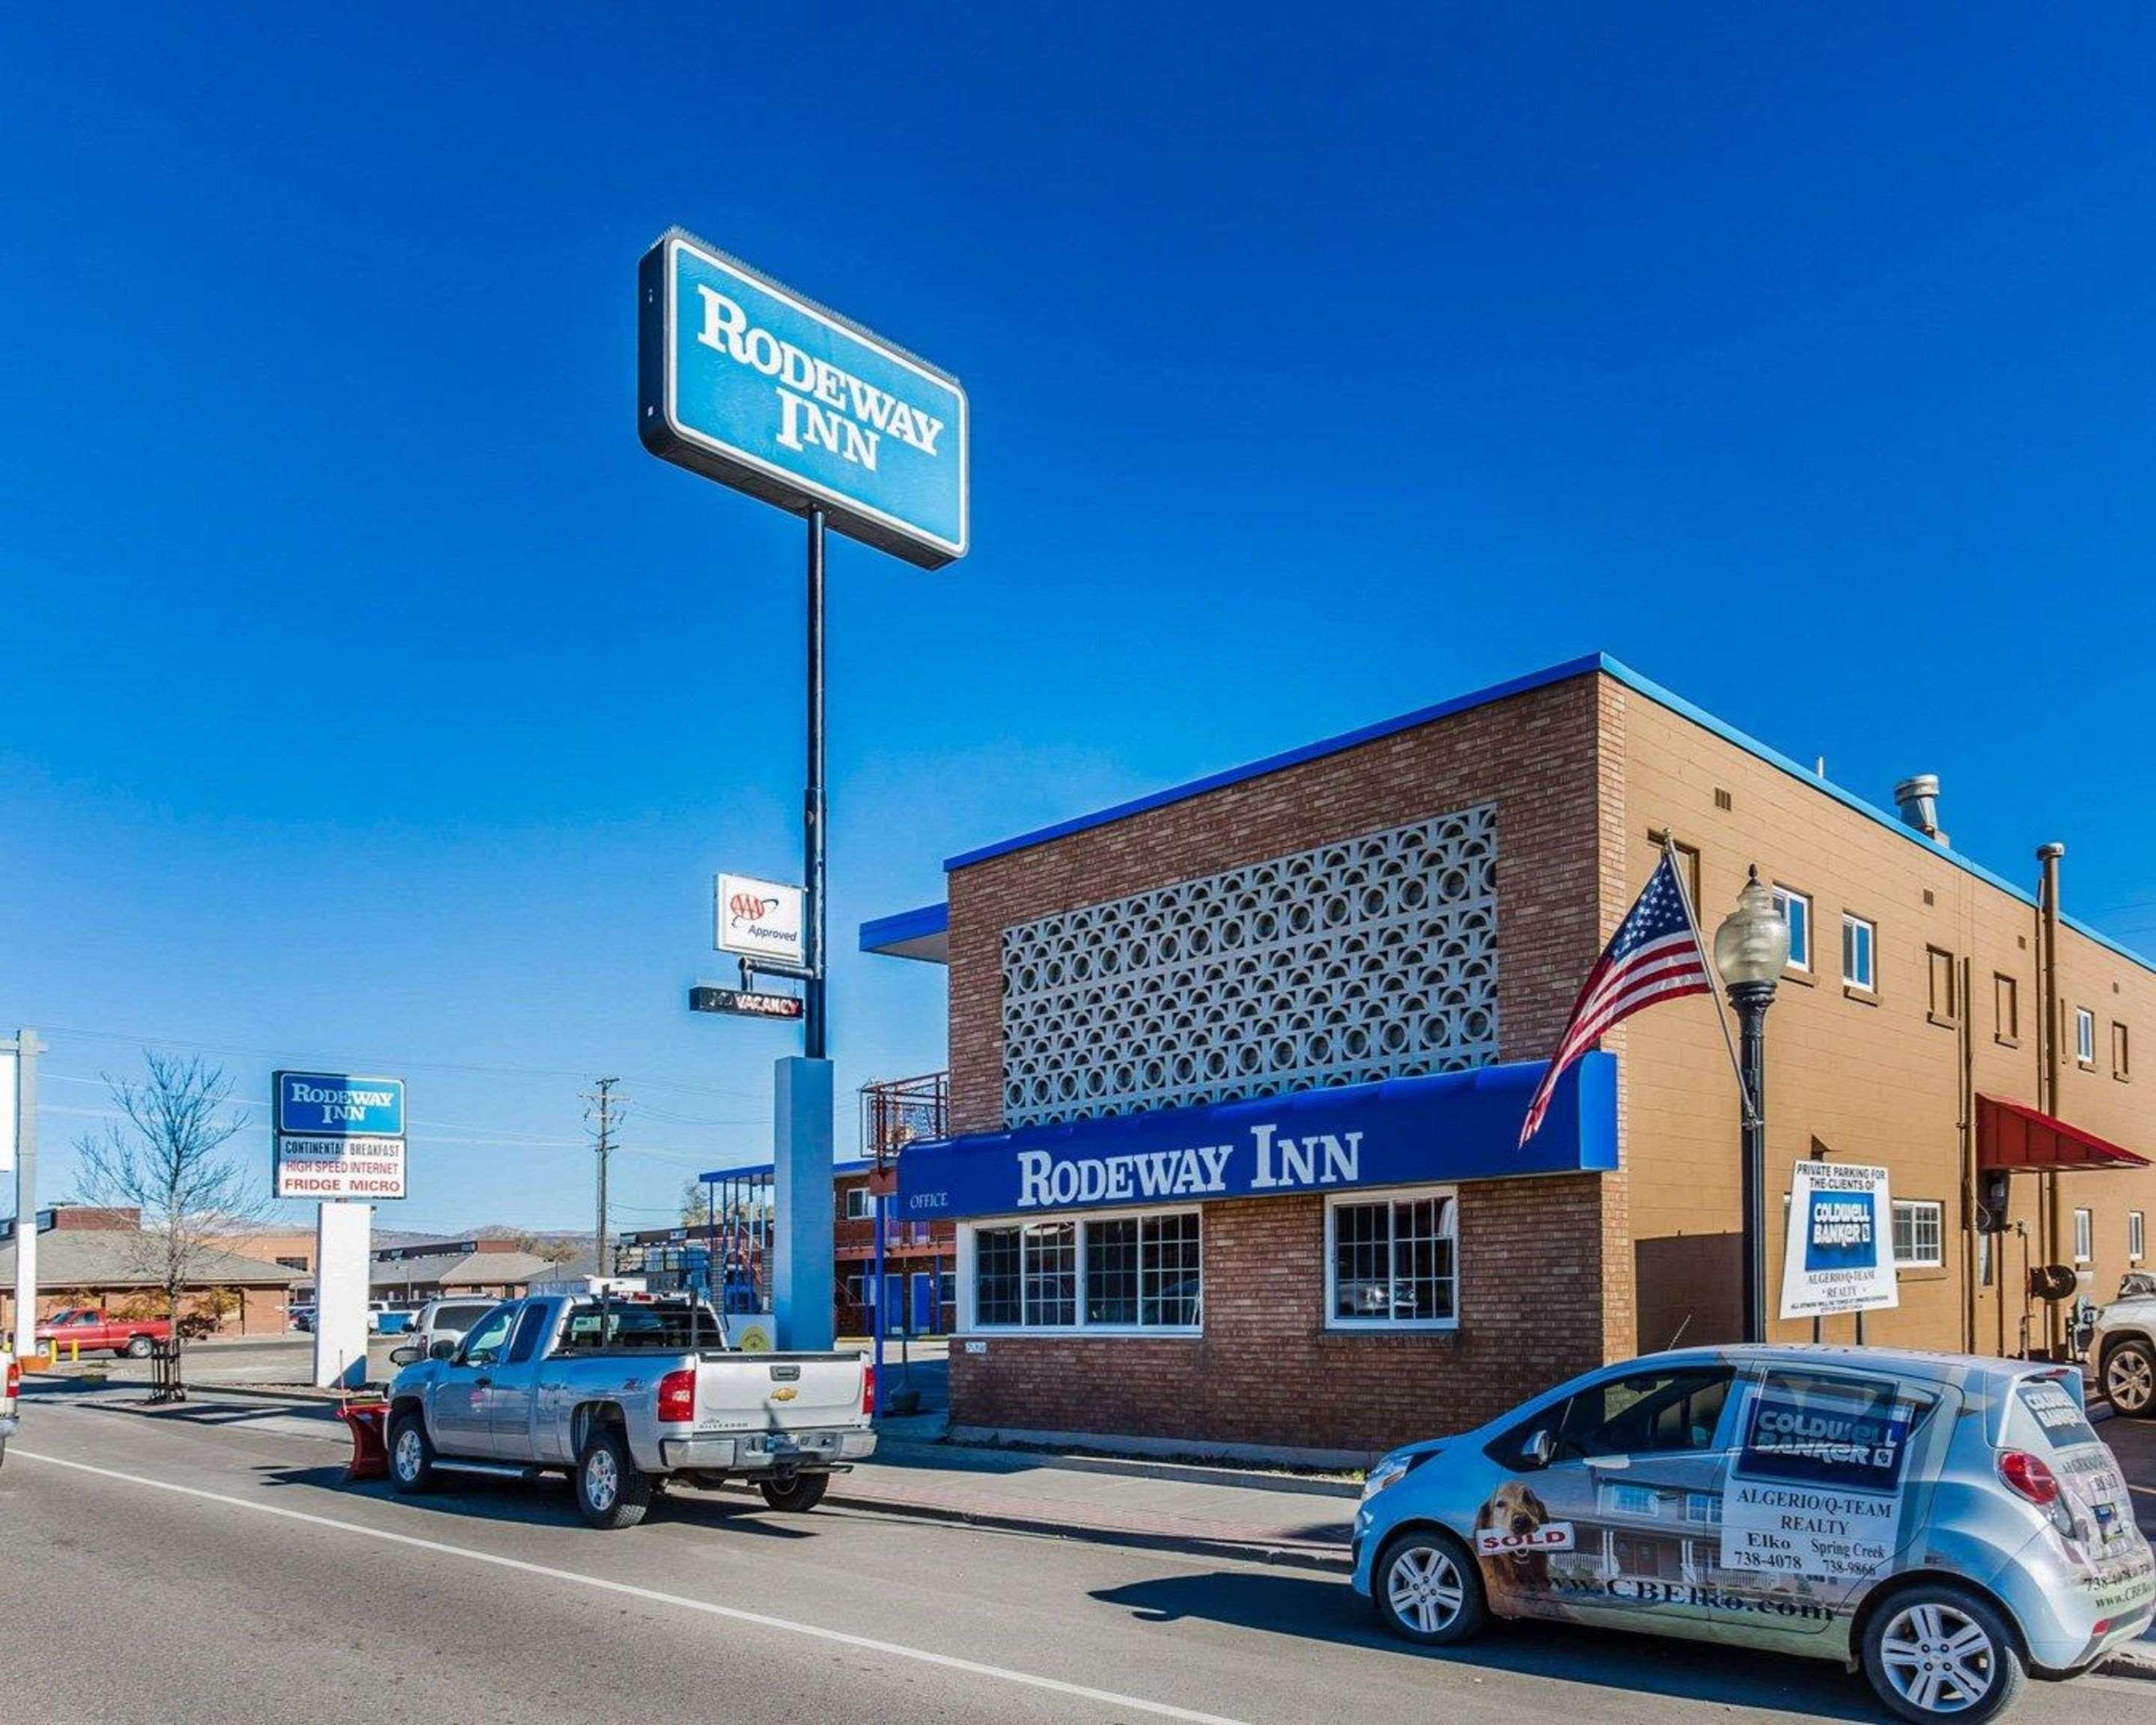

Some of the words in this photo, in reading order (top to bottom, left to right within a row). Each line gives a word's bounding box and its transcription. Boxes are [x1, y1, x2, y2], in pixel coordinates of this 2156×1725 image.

[698, 284, 944, 457] RODEWAY
[776, 386, 880, 471] INN
[749, 924, 797, 941] Approved
[734, 994, 799, 1014] VACANCY
[291, 1083, 394, 1107] RODEWAY
[322, 1105, 367, 1123] INN
[285, 1141, 345, 1155] CONTINENTAL
[349, 1144, 400, 1157] BREAKFAST
[286, 1160, 312, 1173] HIGH
[315, 1161, 348, 1173] SPEED
[350, 1162, 398, 1175] INTERNET
[1017, 1145, 1234, 1206] RODEWAY
[1251, 1125, 1363, 1188] INN
[1797, 1163, 1831, 1176] PRIVATE
[1833, 1166, 1870, 1179] PARKING
[1872, 1169, 1886, 1179] FOR
[284, 1178, 341, 1190] FRIDGE
[349, 1180, 400, 1192] MICRO
[1810, 1177, 1827, 1189] THE
[1828, 1178, 1863, 1190] CLIENTS
[1865, 1180, 1875, 1190] OF
[910, 1192, 948, 1209] OFFICE
[1827, 1286, 1857, 1298] REALTY
[1738, 1488, 1892, 1518] ALGERIO/Q-TEAM
[1781, 1515, 1851, 1535] REALTY
[1483, 1531, 1566, 1548] SOLD
[1747, 1532, 1791, 1550] Elko
[1810, 1539, 1851, 1558] Spring
[1853, 1543, 1886, 1559] Creek
[1735, 1551, 1803, 1570] 738-4078
[1822, 1560, 1877, 1576] 738-9866
[1531, 1576, 1833, 1621] ww.CBElko.com
